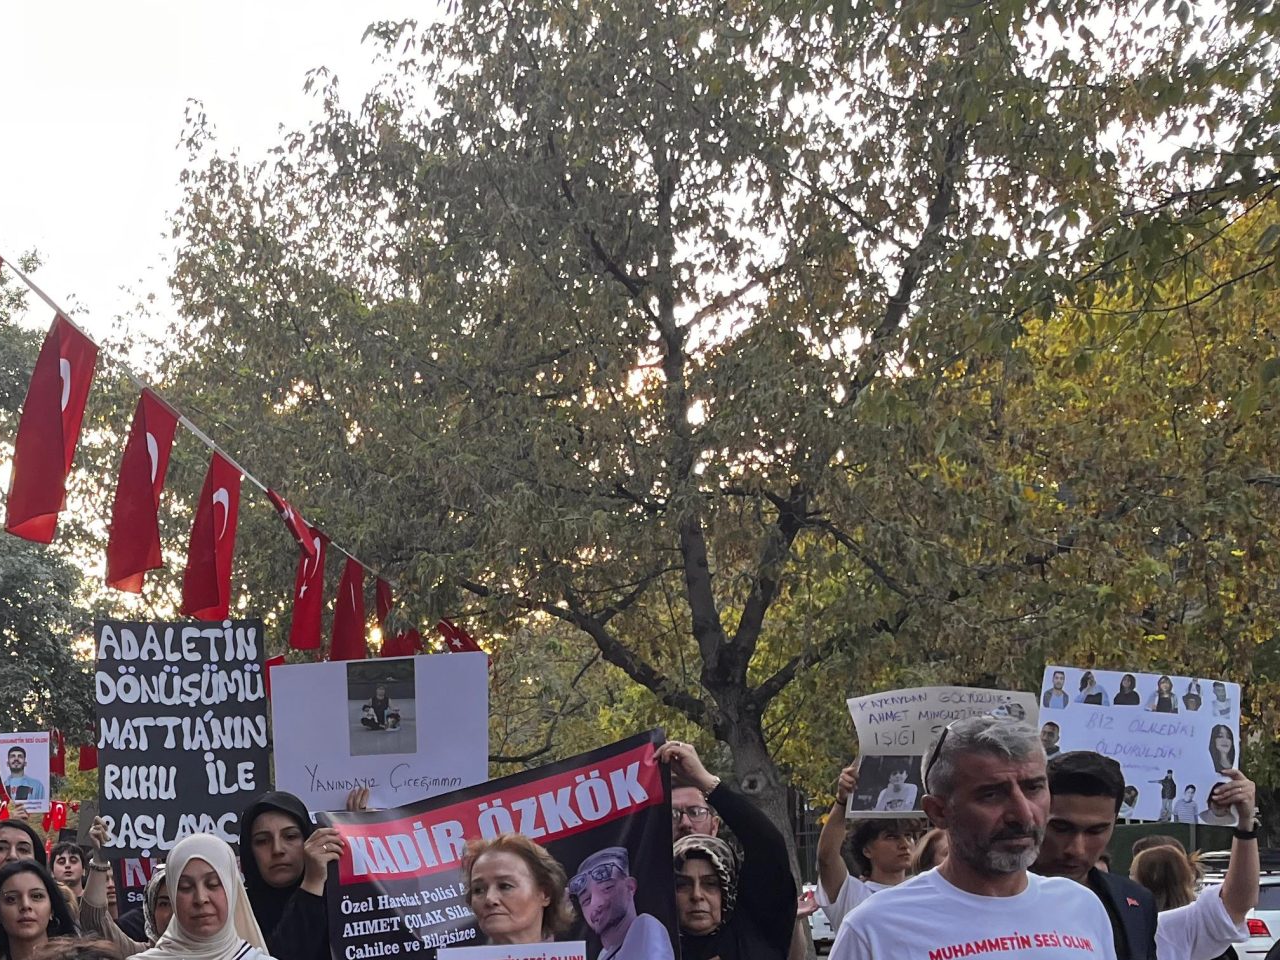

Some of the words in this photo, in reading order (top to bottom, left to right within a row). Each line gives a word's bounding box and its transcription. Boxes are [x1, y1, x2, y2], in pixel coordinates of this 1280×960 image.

[97, 620, 257, 662] ADALETİN
[96, 663, 265, 707] DÖNÜŞÜMÜ
[104, 764, 177, 800] RUHU
[204, 752, 256, 795] İLE
[100, 812, 240, 858] BAŞLAYAC
[347, 819, 466, 875] KADİR
[478, 761, 649, 846] ÖZKÖK
[341, 895, 375, 915] Özel
[377, 893, 422, 911] Harekat
[421, 885, 458, 905] Polisi
[343, 917, 401, 938] AHMET
[404, 909, 444, 934] ÇOLAK
[346, 942, 400, 960] Cahilce
[404, 940, 420, 952] ve
[423, 927, 476, 949] Bilgisizce
[1033, 930, 1062, 949] SESİ
[1063, 934, 1095, 953] OLUN!
